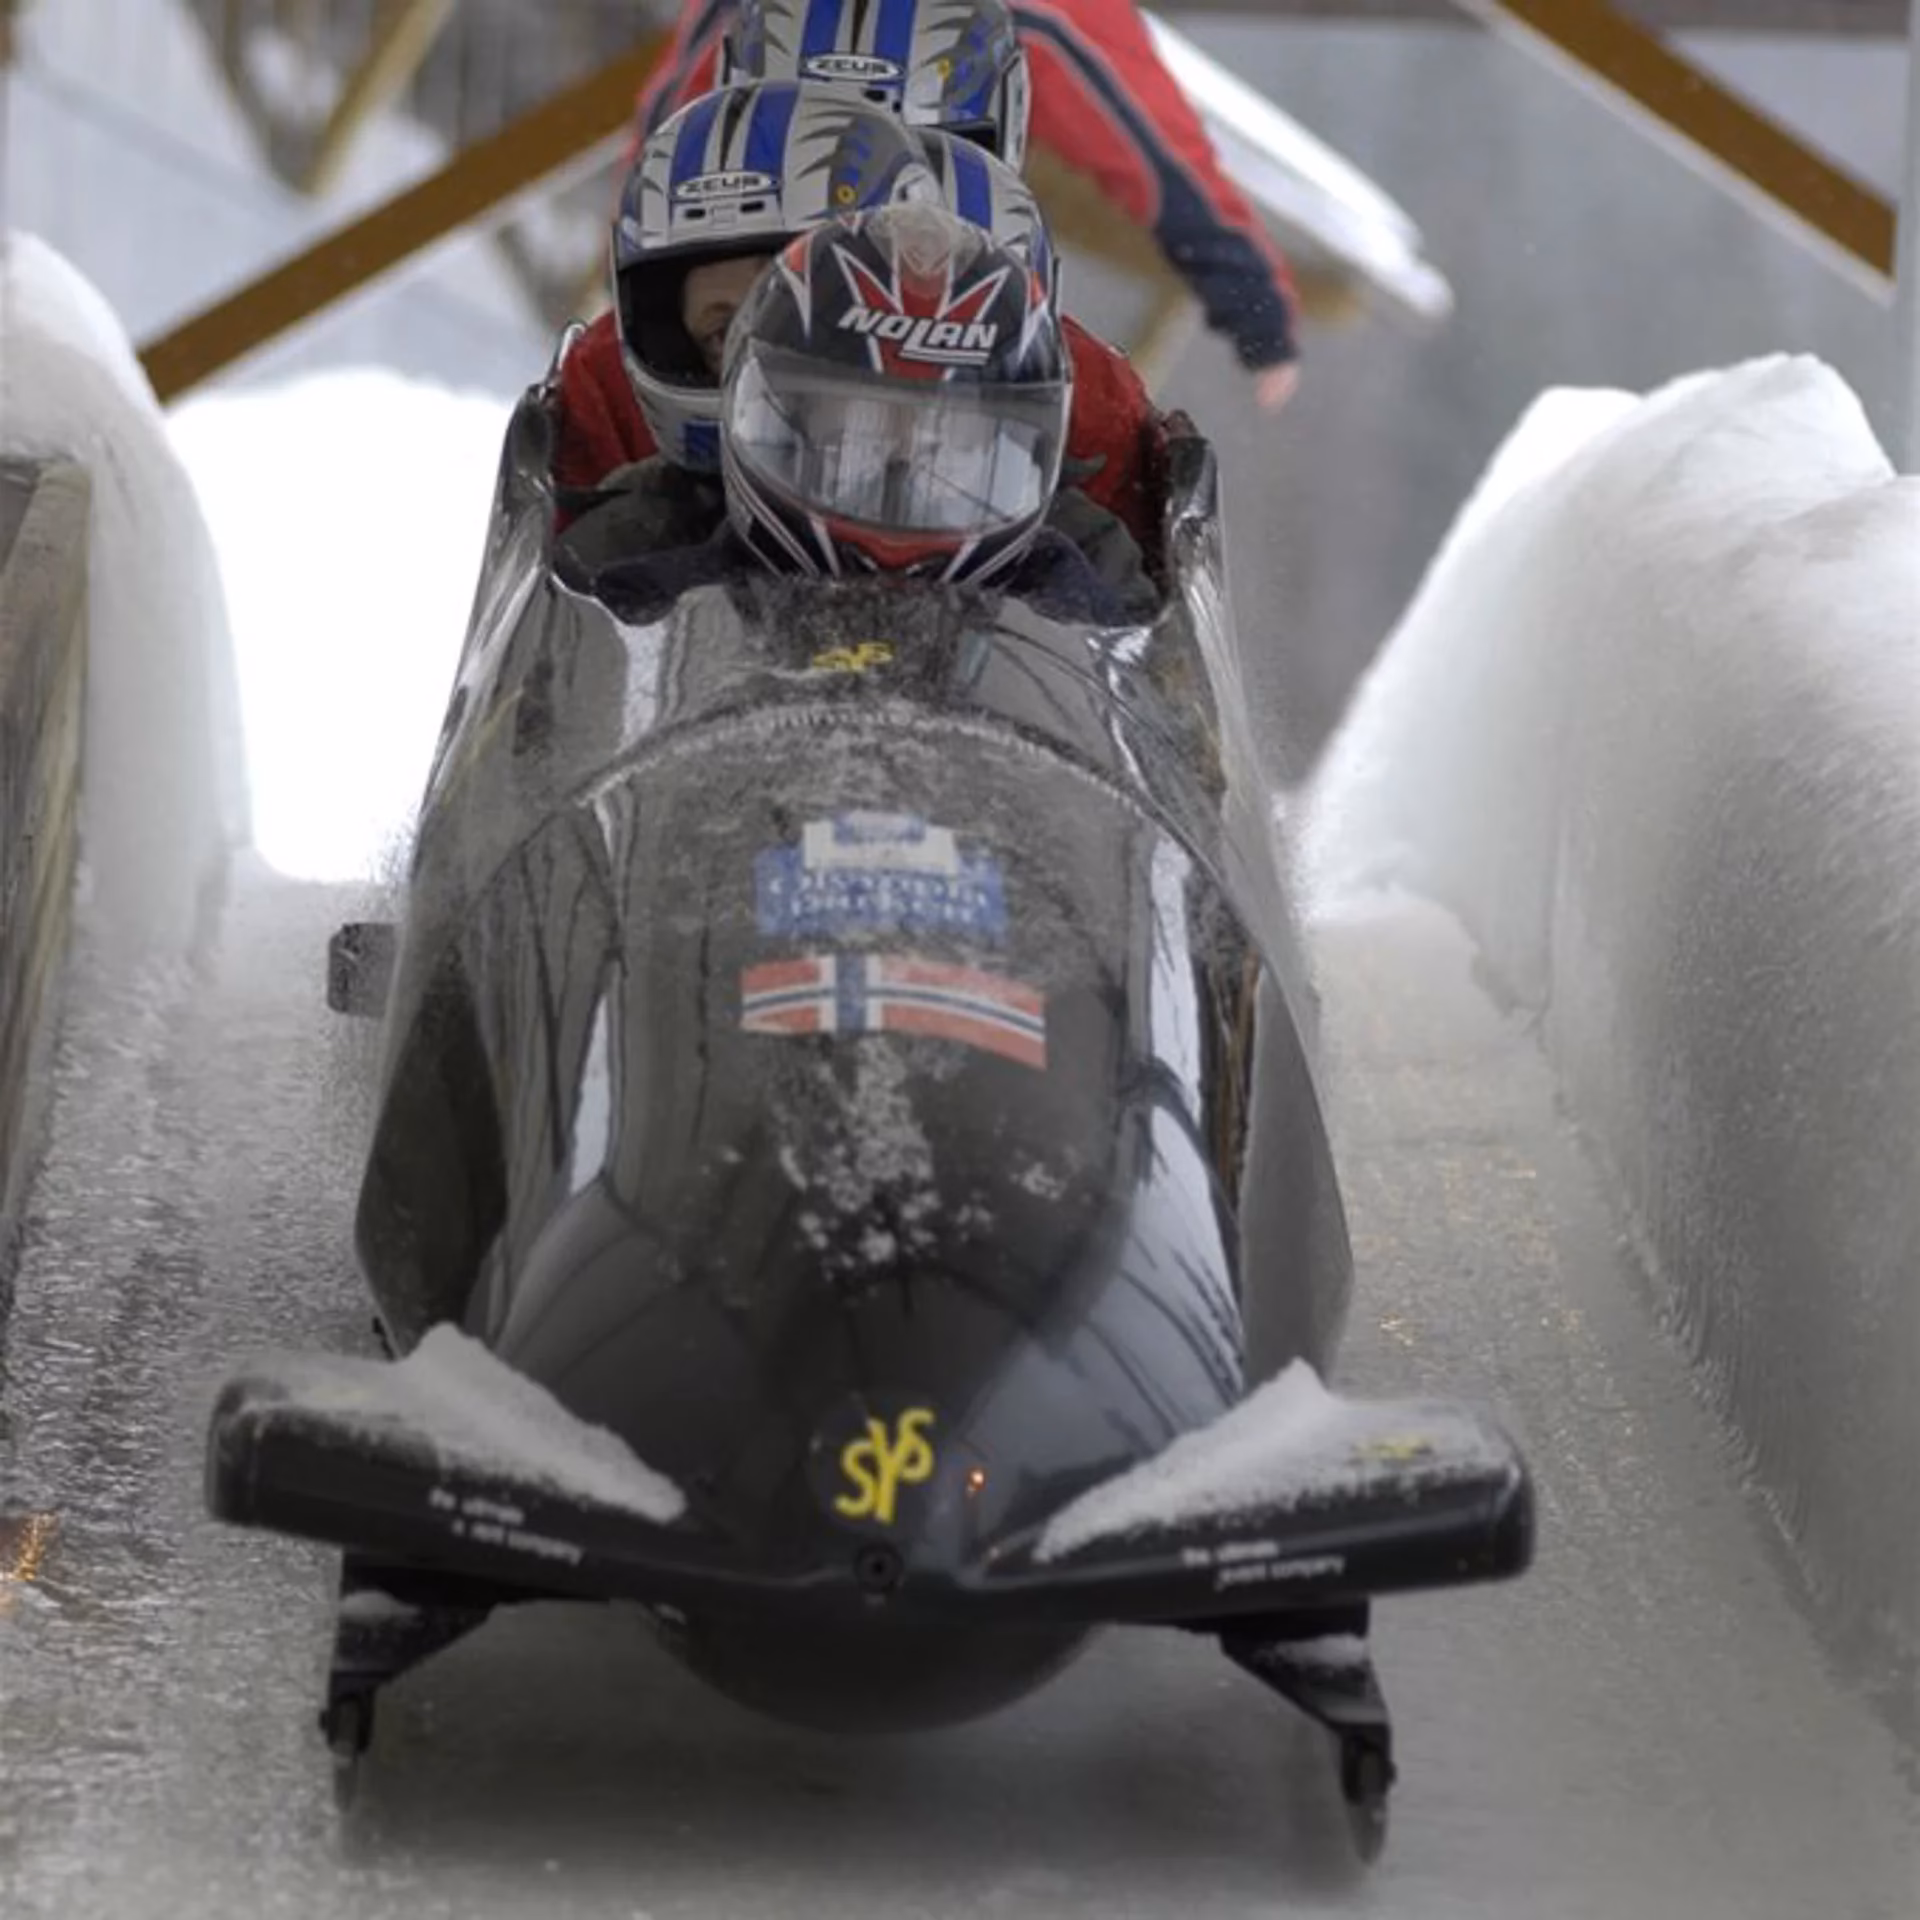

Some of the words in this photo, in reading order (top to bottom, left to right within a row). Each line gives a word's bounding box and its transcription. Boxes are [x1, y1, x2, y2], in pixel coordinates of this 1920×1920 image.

[814, 59, 889, 77] ZEUS
[683, 175, 762, 194] ZEUS
[836, 305, 999, 359] NOLAN
